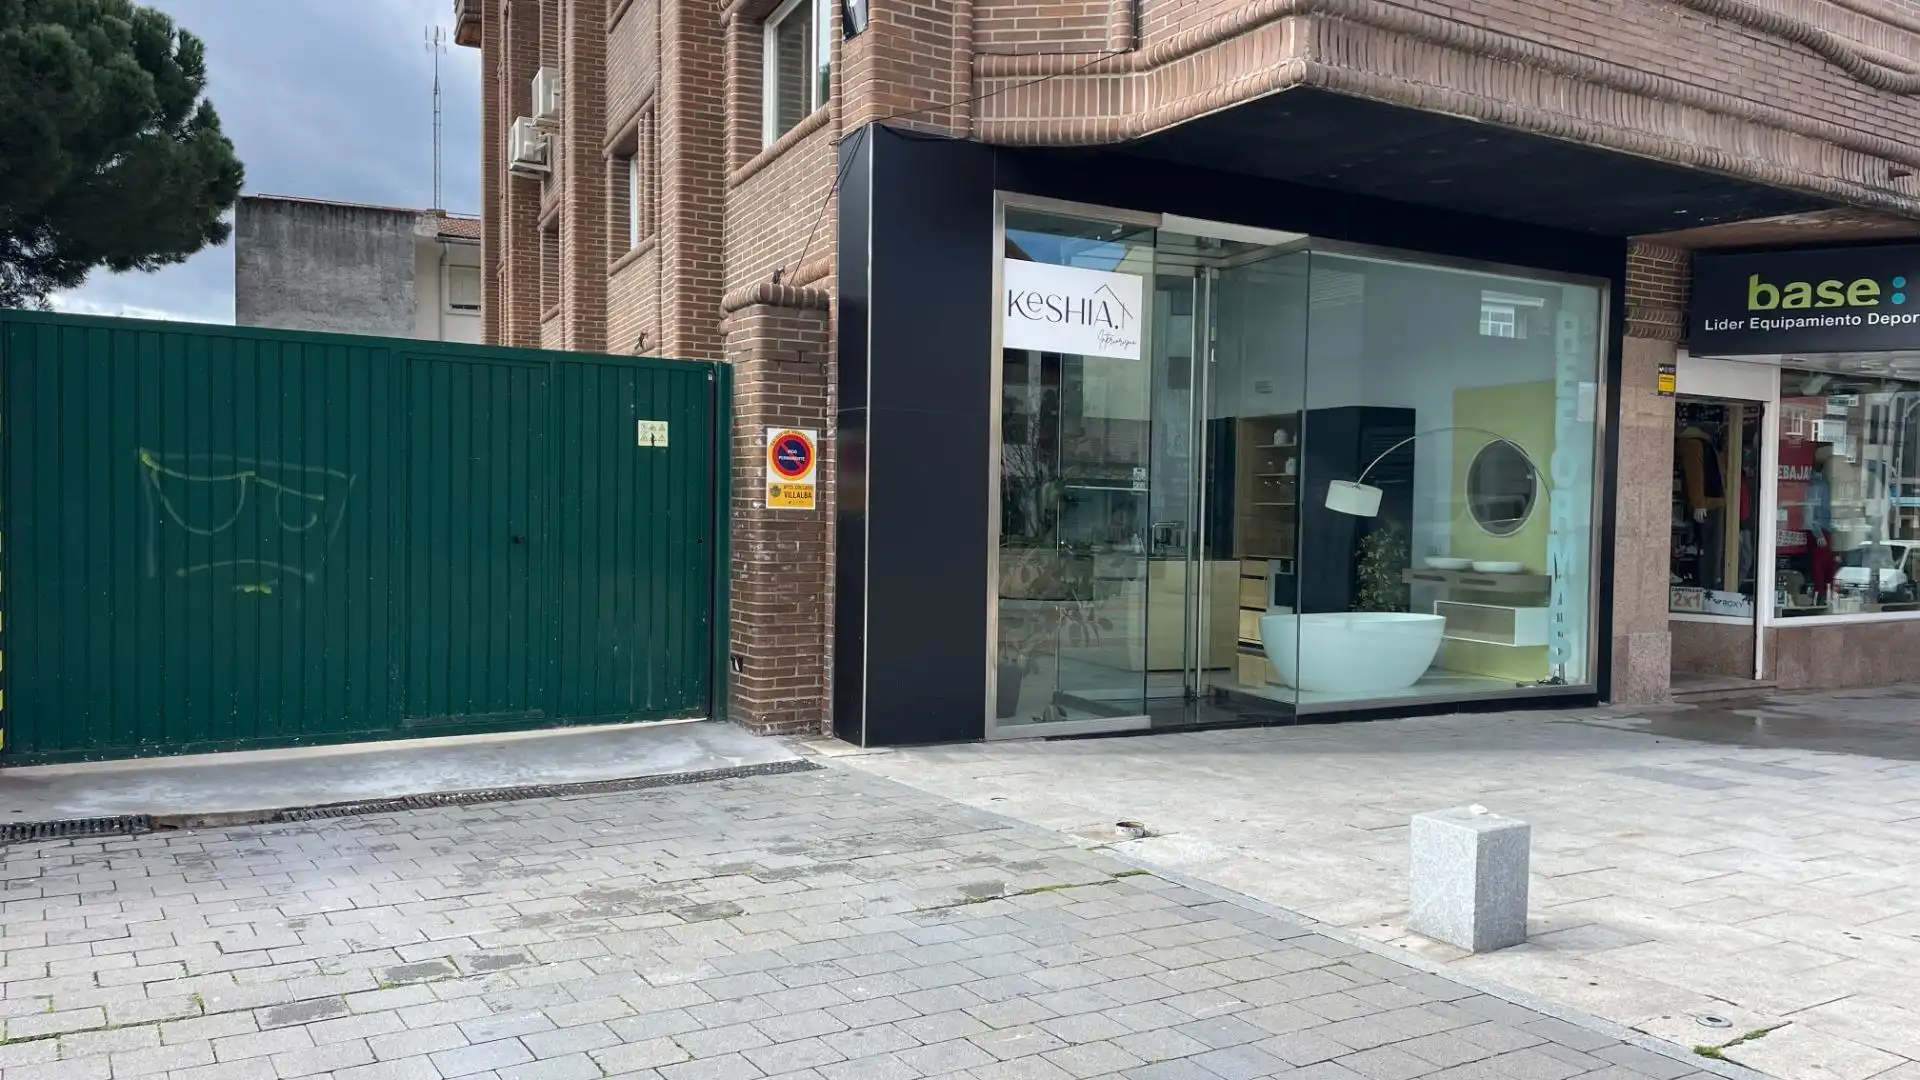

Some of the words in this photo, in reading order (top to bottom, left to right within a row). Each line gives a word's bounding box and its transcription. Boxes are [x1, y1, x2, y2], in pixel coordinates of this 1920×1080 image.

[1750, 313, 1861, 332] Equipamiento
[1776, 464, 1813, 480] EBAJA
[784, 491, 812, 499] VILLALBA
